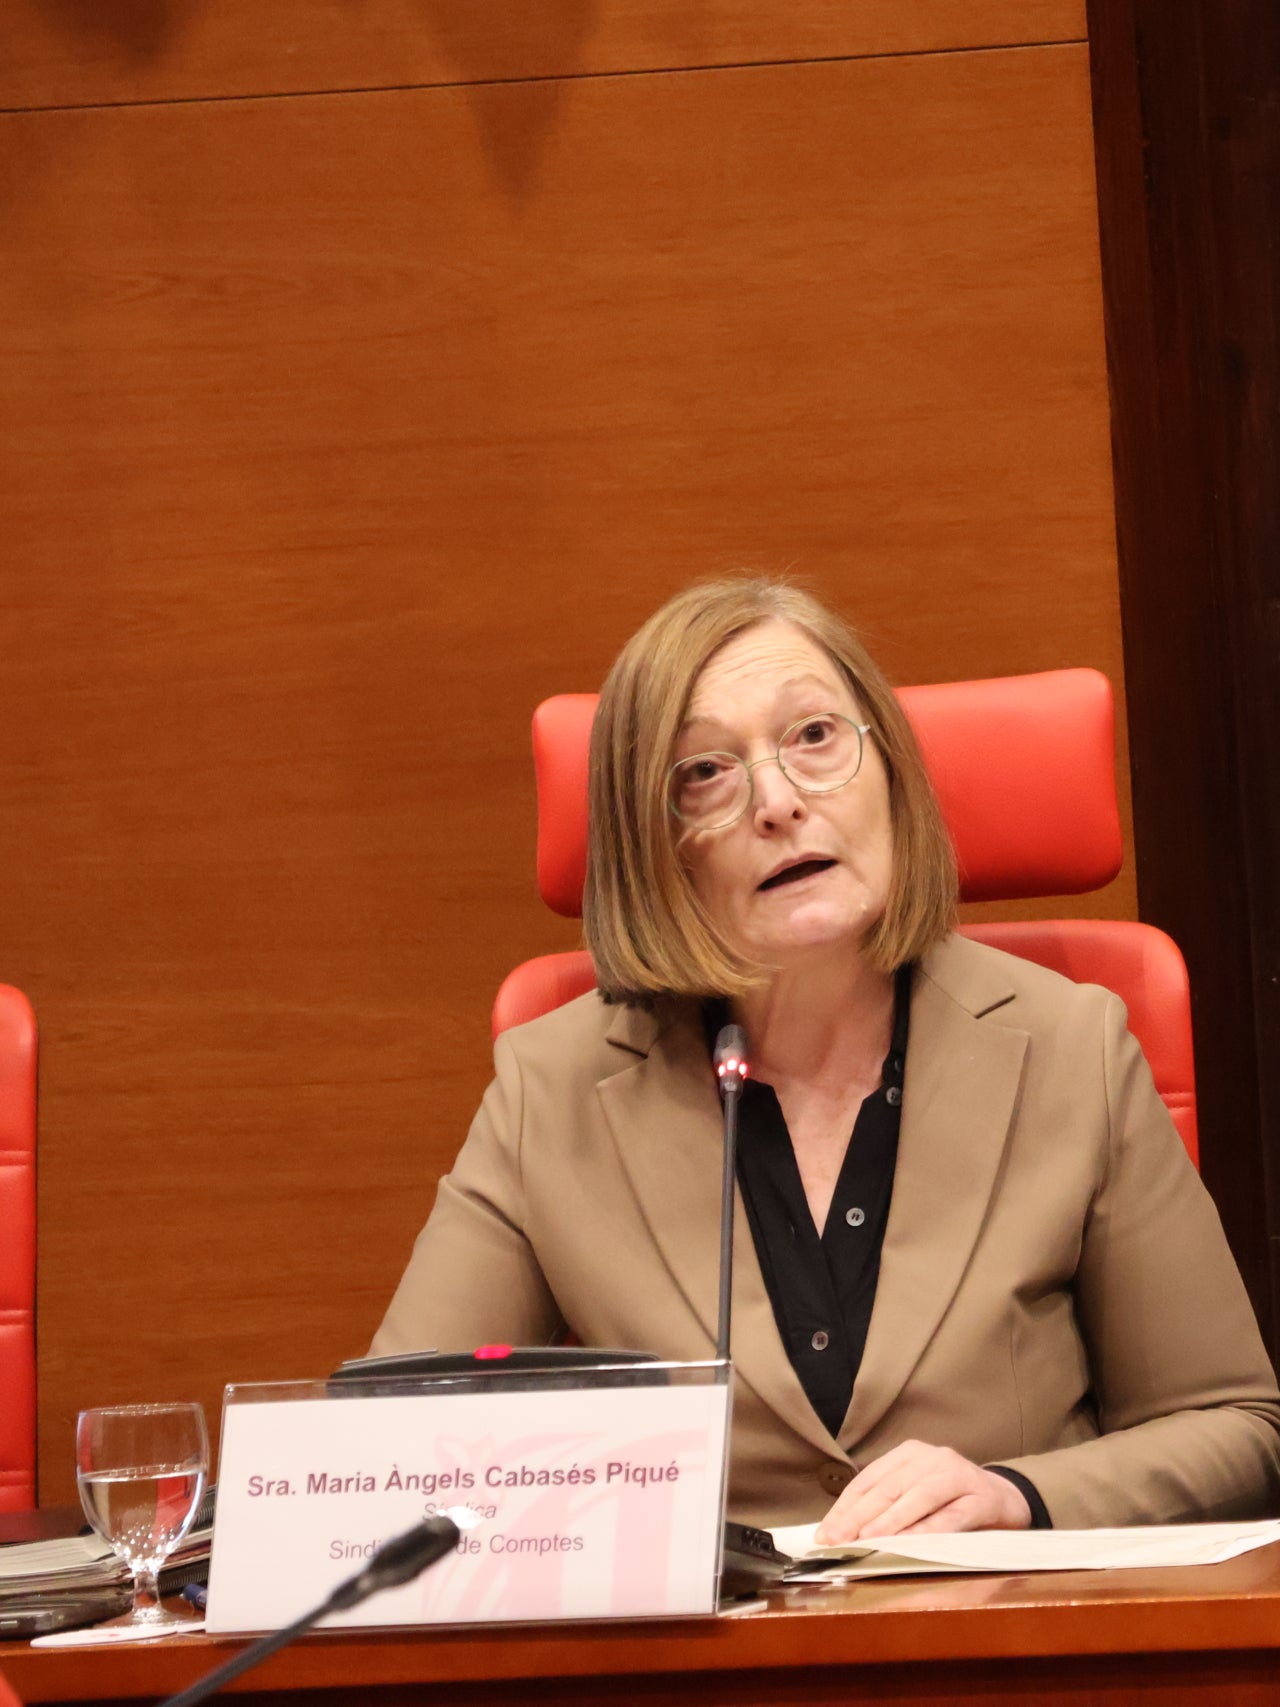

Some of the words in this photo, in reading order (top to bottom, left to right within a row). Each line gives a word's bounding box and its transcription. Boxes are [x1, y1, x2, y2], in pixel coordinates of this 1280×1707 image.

[247, 1474, 296, 1497] Sra.
[306, 1470, 376, 1494] Maria
[385, 1464, 475, 1498] Àngels
[485, 1463, 595, 1488] Cabasés
[606, 1459, 680, 1488] Piqué
[456, 1534, 481, 1556] de
[489, 1531, 585, 1559] Comptes
